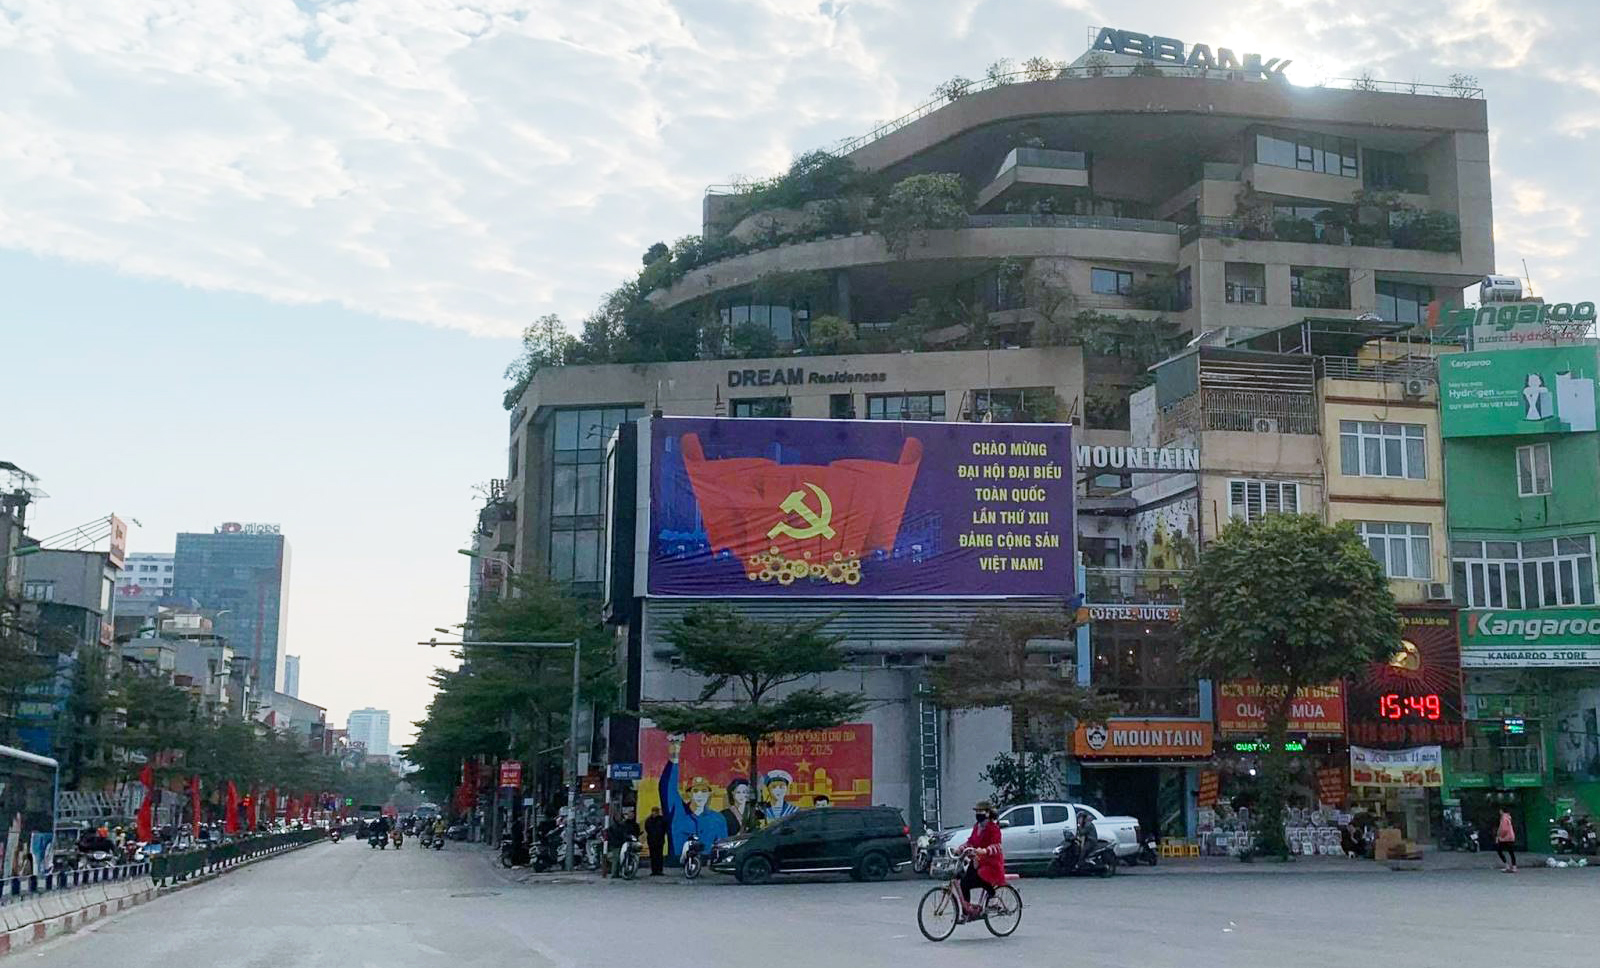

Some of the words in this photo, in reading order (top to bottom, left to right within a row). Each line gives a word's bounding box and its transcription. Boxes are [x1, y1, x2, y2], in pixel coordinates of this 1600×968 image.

[1093, 27, 1293, 86] ABBANK
[727, 368, 804, 387] DREAM
[808, 370, 887, 384] Residences
[972, 440, 1007, 456] CHÀO
[1010, 440, 1048, 456] MỪNG
[1076, 445, 1200, 470] MOUNTAIN
[958, 465, 979, 480] ĐẠI
[983, 462, 1005, 481] HỘI
[1008, 465, 1030, 481] ĐẠI
[1033, 461, 1062, 479] BIỂU
[975, 485, 1008, 501] TOÀN
[1011, 484, 1046, 503] QUỐC
[972, 506, 996, 524] LẦN
[1000, 508, 1026, 524] THỨ
[1028, 511, 1049, 524] XIII
[959, 530, 993, 547] ĐẢNG
[997, 531, 1032, 550] CỘNG
[1035, 530, 1059, 547] SẢN
[979, 554, 1008, 573] VIỆT
[1011, 557, 1044, 571] NAM!
[1089, 607, 1133, 620] COFFEE
[1137, 607, 1170, 620] JUICE
[1468, 612, 1600, 641] Kangaroo
[1487, 651, 1547, 660] KANGAROO
[1553, 651, 1588, 660] STORE
[1291, 701, 1325, 718] MÙA
[1380, 694, 1441, 719] 15:49
[1113, 730, 1203, 746] MOUNTAIN
